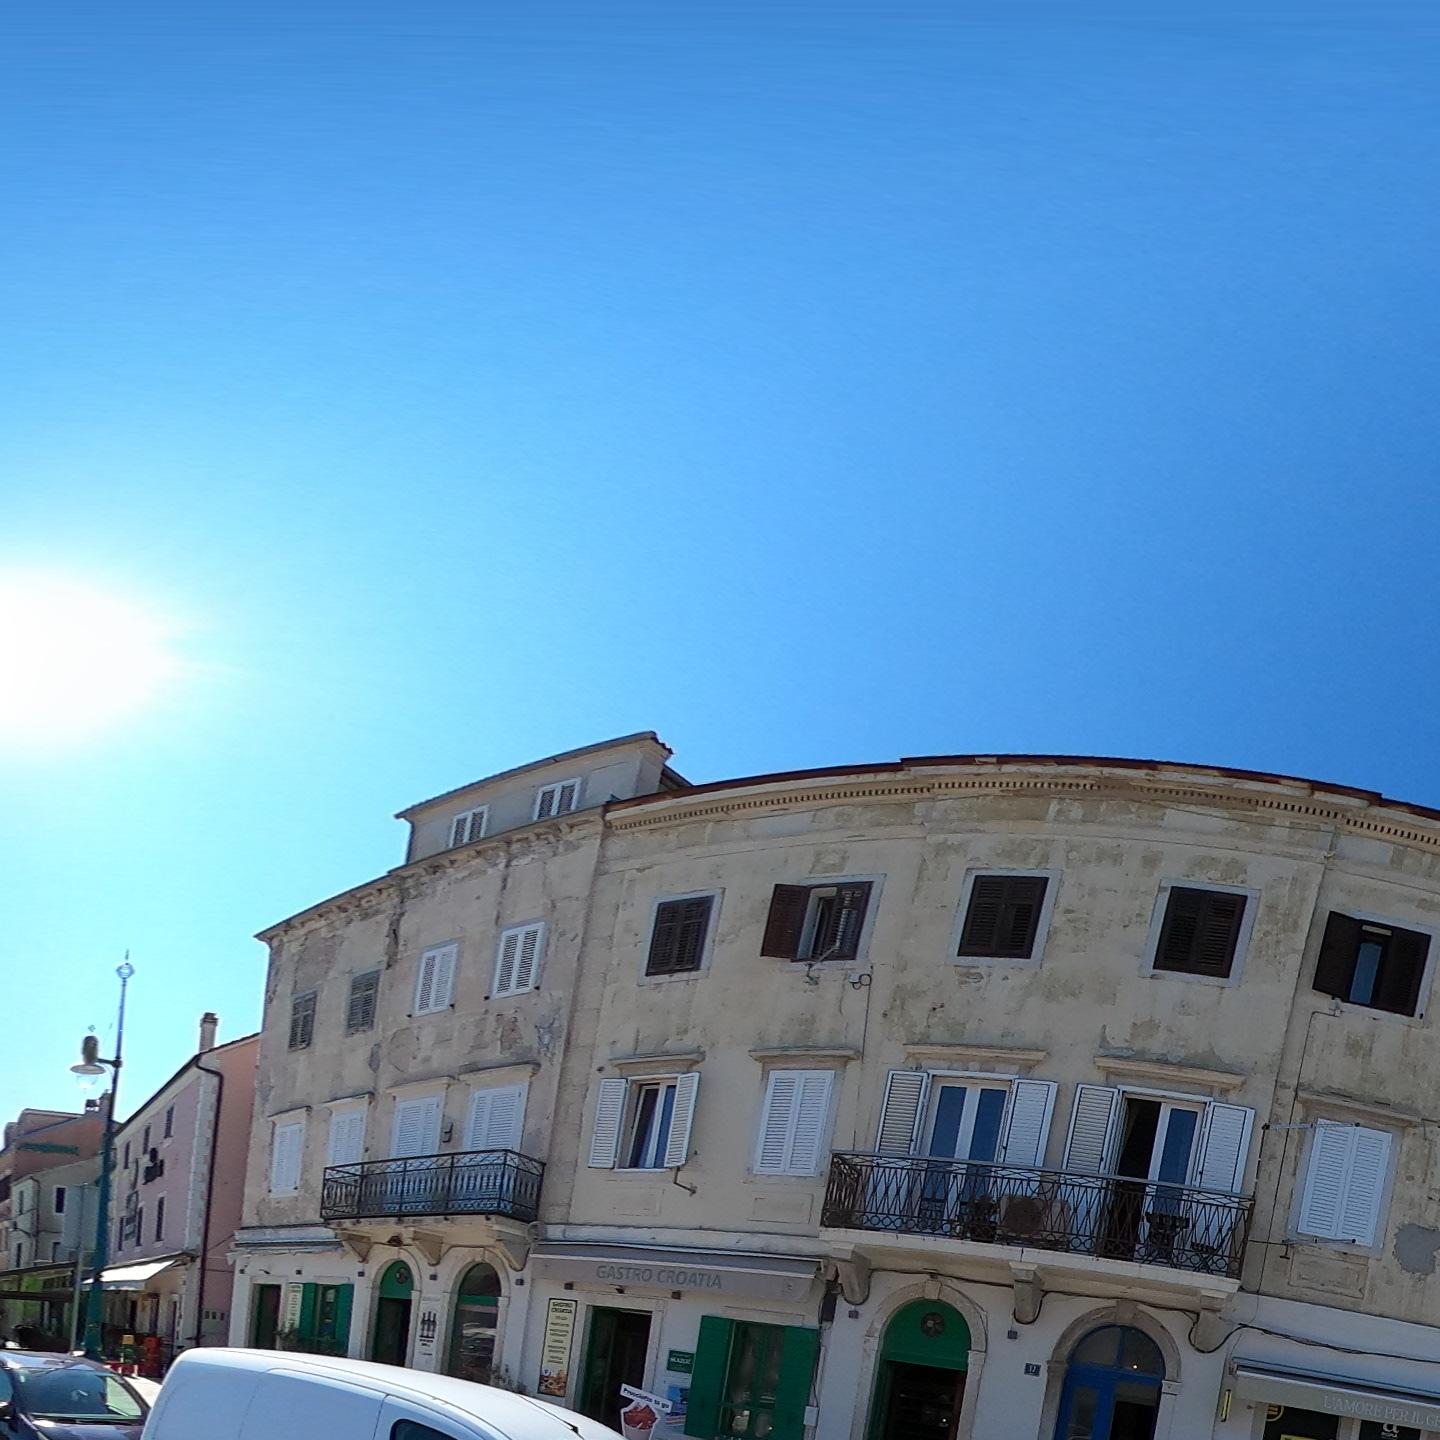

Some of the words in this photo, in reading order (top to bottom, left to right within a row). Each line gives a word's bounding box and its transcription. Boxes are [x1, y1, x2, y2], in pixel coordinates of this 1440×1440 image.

[596, 1265, 653, 1282] GASTRO
[656, 1269, 723, 1289] CROATIA
[1323, 1395, 1381, 1417] L'AMORE
[1384, 1406, 1409, 1423] PER
[1410, 1410, 1424, 1425] IL
